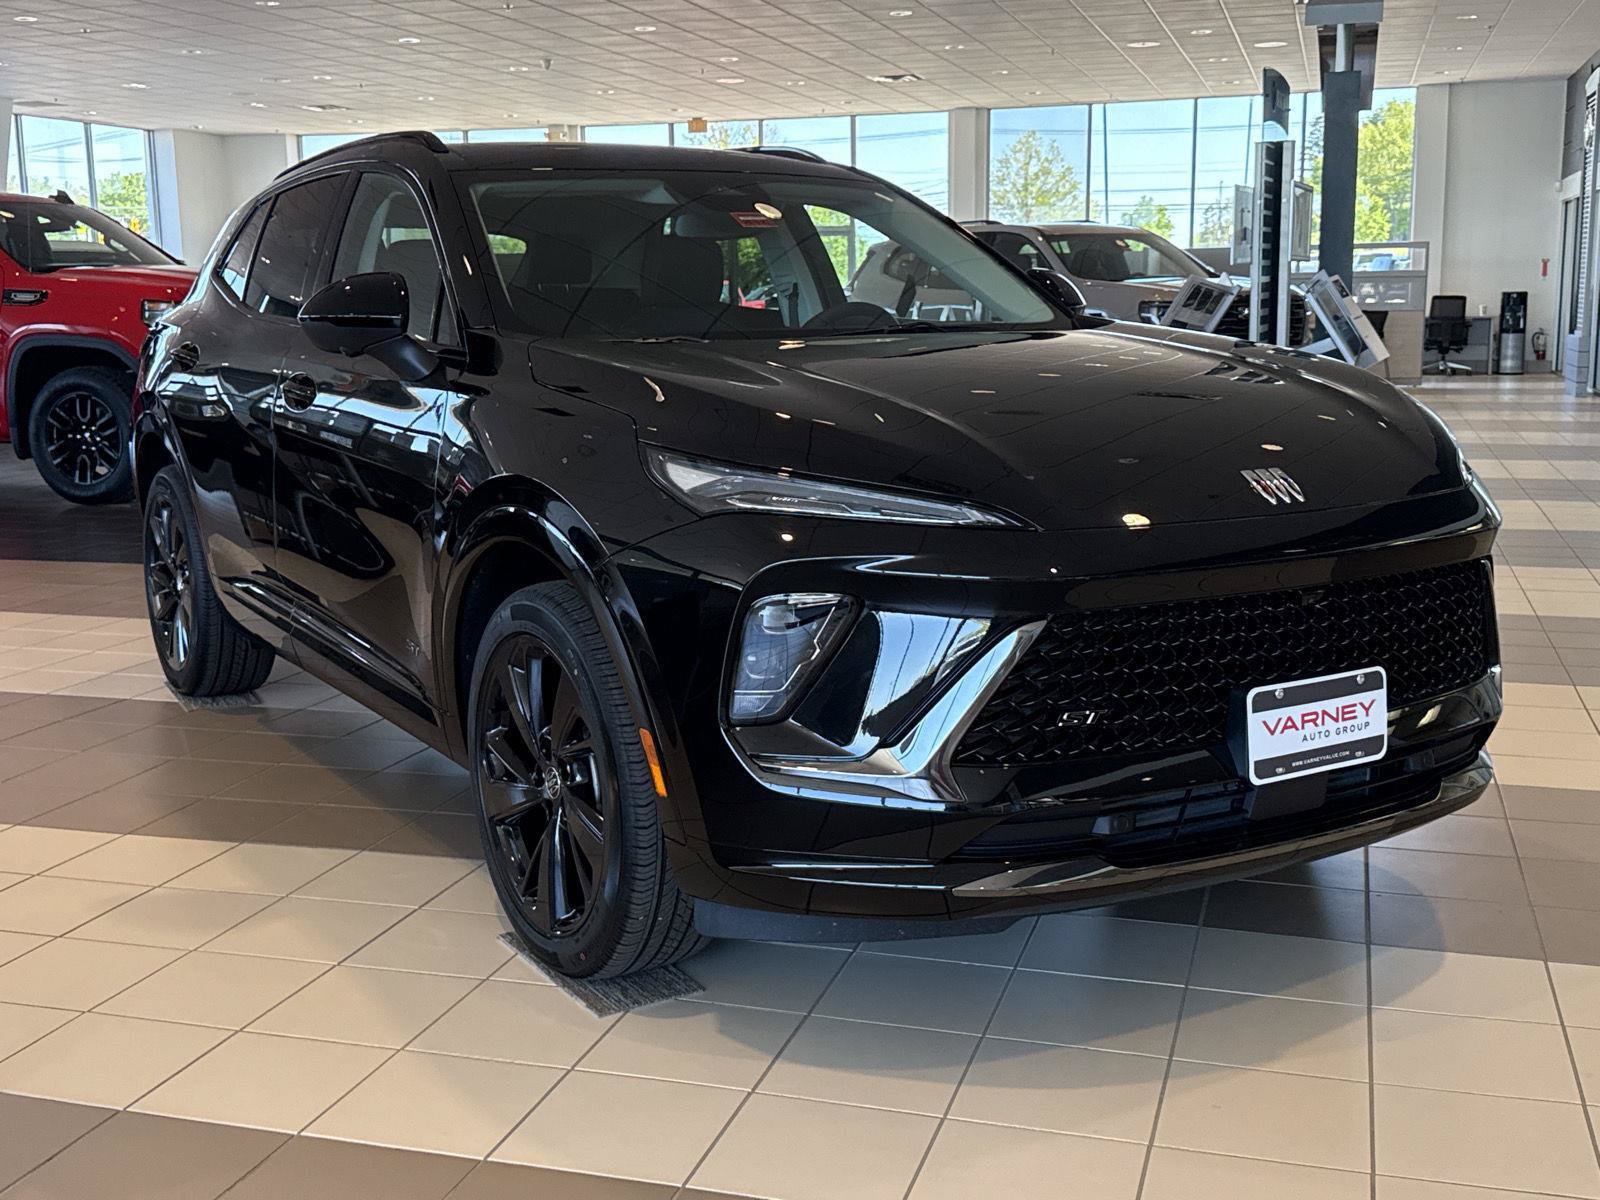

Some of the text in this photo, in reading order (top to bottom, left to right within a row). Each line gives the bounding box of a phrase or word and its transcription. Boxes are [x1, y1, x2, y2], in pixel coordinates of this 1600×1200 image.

[1262, 699, 1376, 736] VARNEY
[1301, 721, 1371, 743] AUTO GROUP
